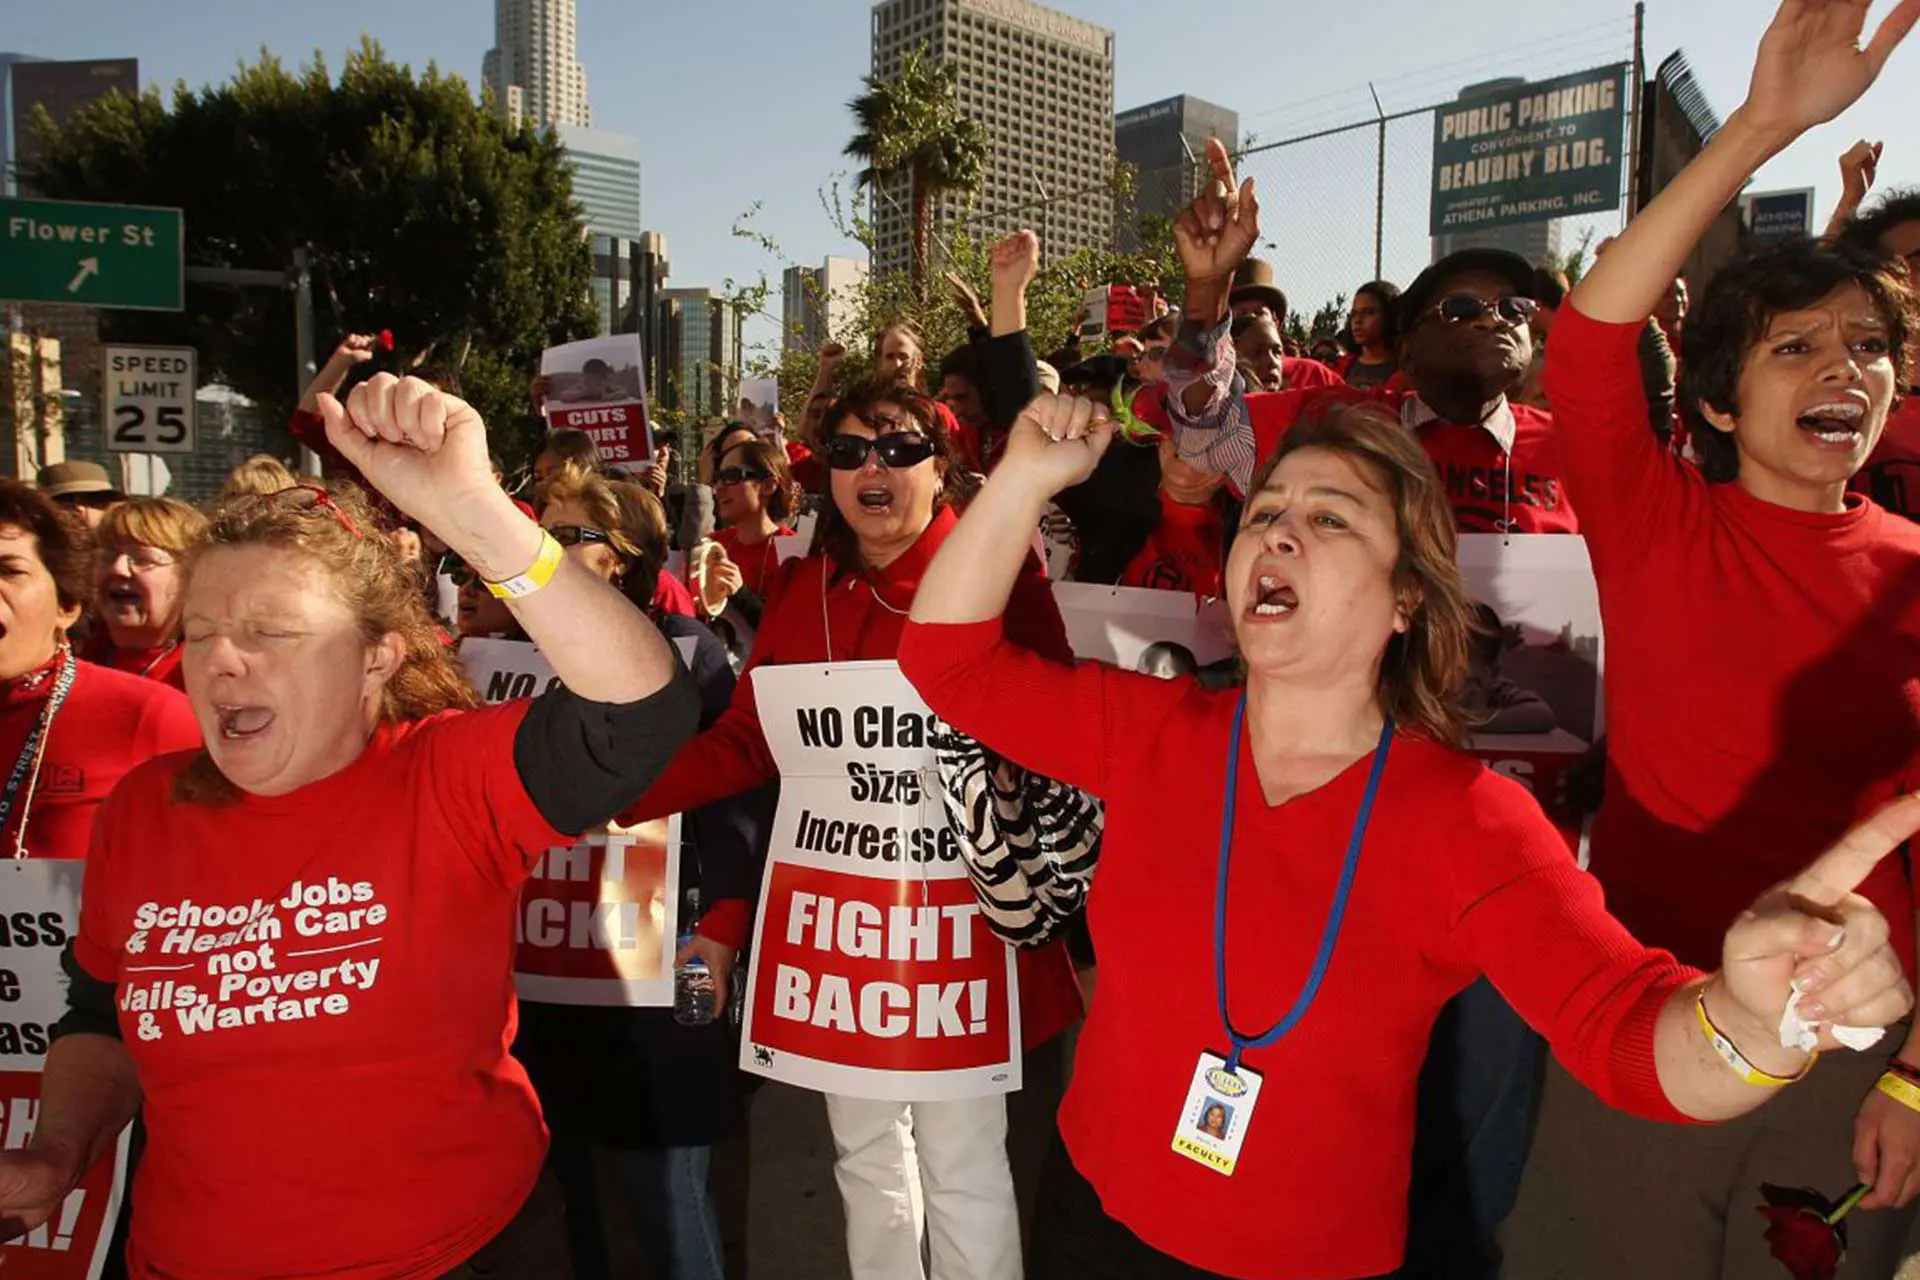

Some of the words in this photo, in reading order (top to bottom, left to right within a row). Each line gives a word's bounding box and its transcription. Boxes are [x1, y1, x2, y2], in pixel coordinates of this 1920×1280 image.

[1442, 102, 1511, 142] PUBLIC
[1518, 79, 1615, 127] PARKING
[1559, 124, 1577, 137] TO
[1545, 138, 1612, 173] BLDG.
[9, 217, 110, 243] Flower
[123, 225, 156, 247] St
[1442, 207, 1496, 226] ATHENA
[112, 356, 188, 375] SPEED
[119, 381, 180, 398] LIMIT
[113, 404, 187, 443] 25
[567, 407, 627, 426] CUTS
[584, 426, 629, 441] URT
[598, 445, 629, 460] DS
[486, 671, 537, 700] NO
[796, 707, 844, 748] NO
[847, 761, 920, 806] Size
[795, 810, 959, 863] Increase
[280, 877, 374, 909] Jobs
[126, 930, 149, 954] &
[161, 915, 281, 954] Health
[294, 904, 388, 937] Care
[517, 898, 640, 949] CK!
[786, 890, 980, 962] FIGHT
[208, 942, 276, 975] not
[120, 981, 208, 1012] Jails,
[219, 958, 380, 1001] Poverty
[773, 964, 989, 1039] BACK!
[137, 1012, 162, 1041] &
[176, 993, 349, 1035] Warfare
[1178, 1139, 1230, 1168] FACULTY
